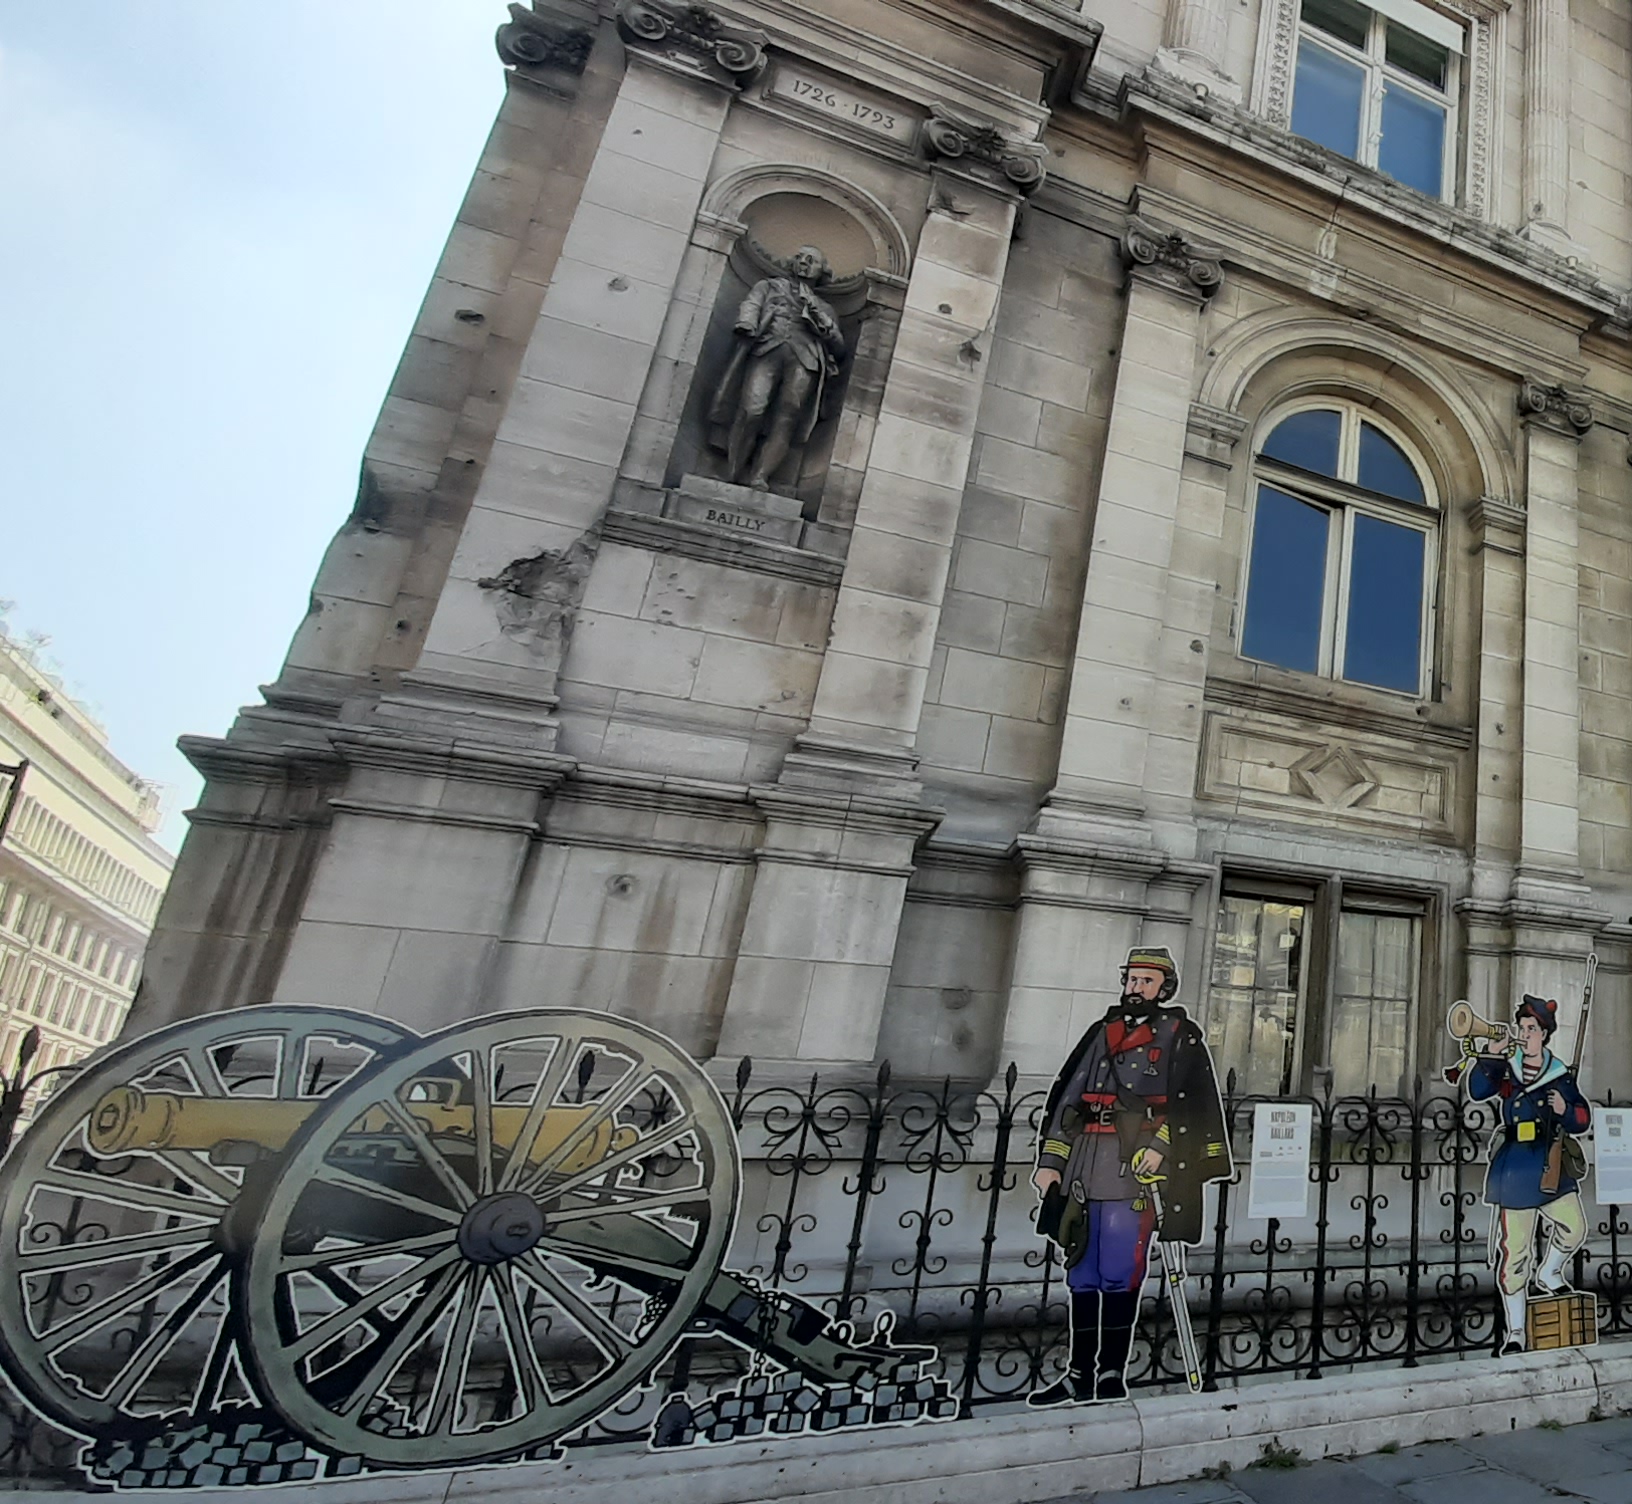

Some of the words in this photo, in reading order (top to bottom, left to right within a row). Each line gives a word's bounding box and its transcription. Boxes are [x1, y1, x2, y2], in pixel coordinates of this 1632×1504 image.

[792, 79, 836, 108] 1726
[852, 103, 896, 130] 1793
[705, 509, 766, 531] BAILLY
